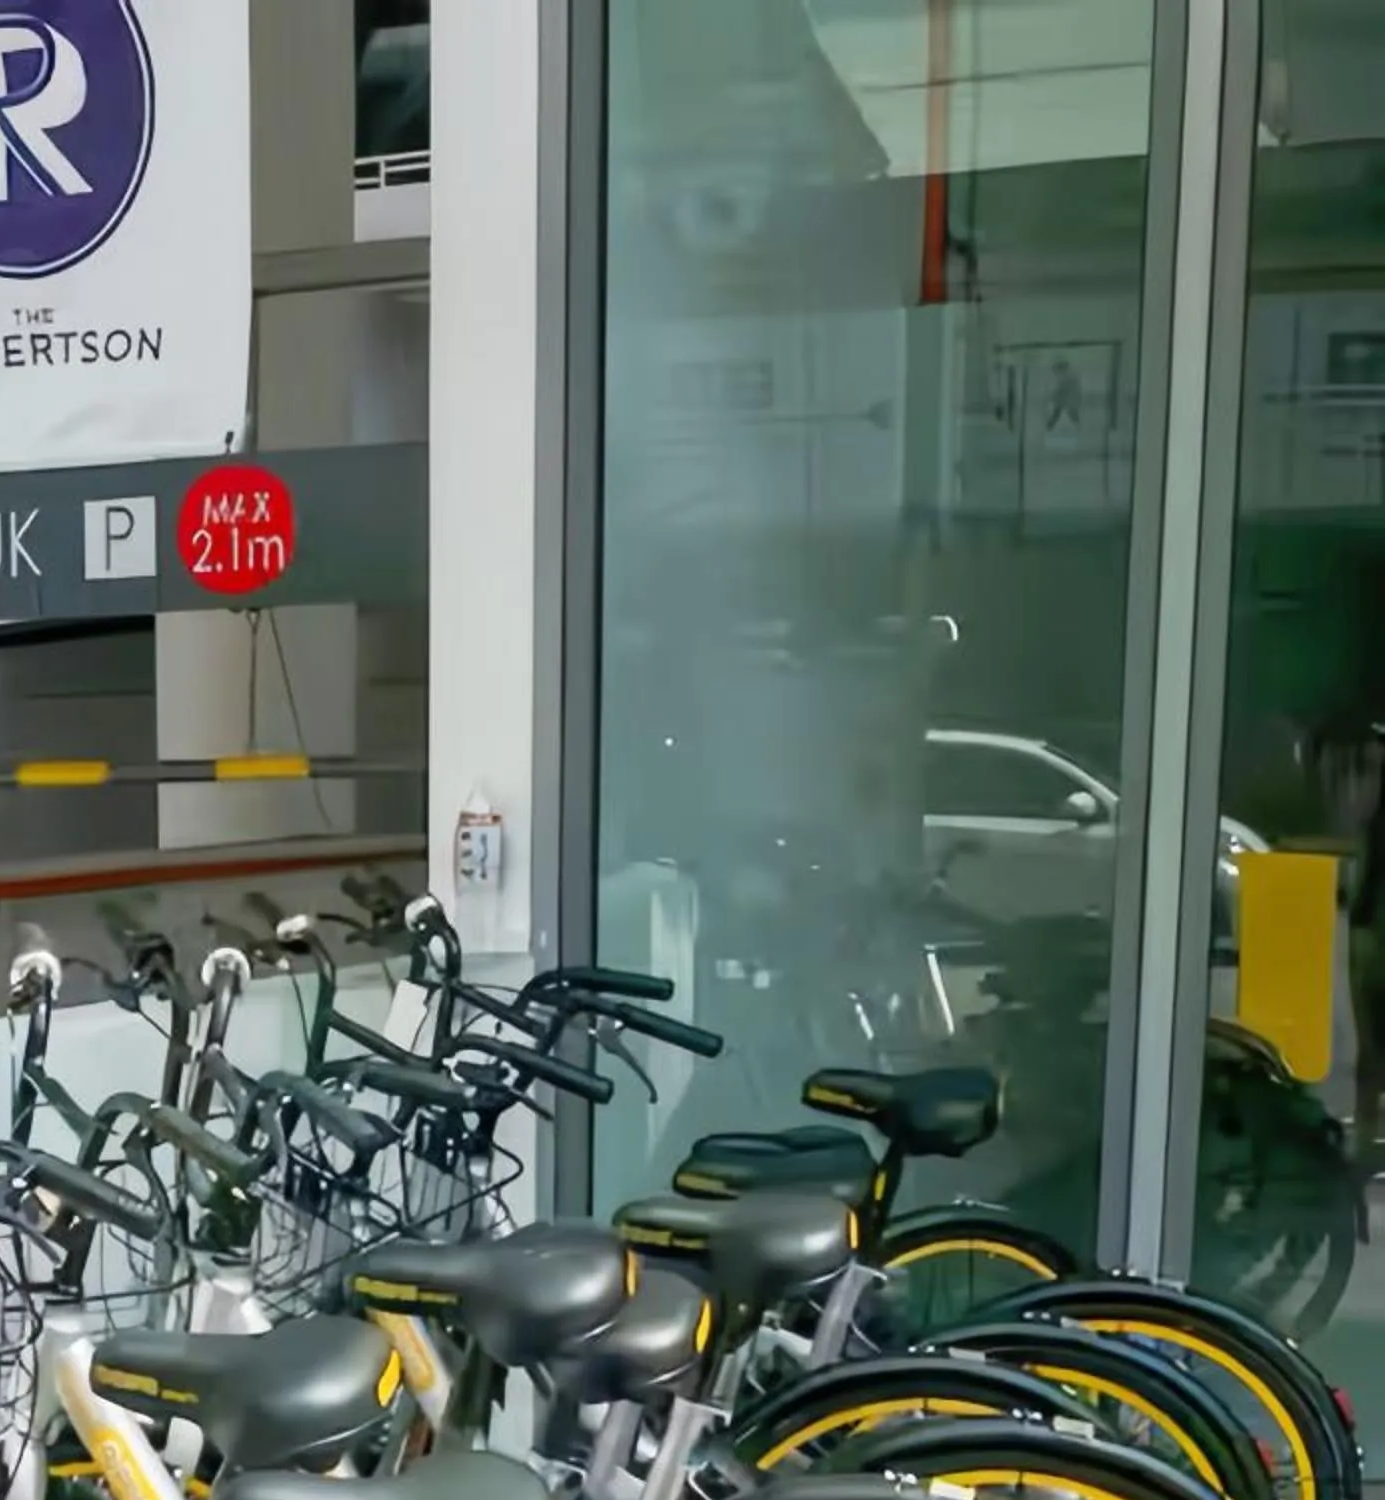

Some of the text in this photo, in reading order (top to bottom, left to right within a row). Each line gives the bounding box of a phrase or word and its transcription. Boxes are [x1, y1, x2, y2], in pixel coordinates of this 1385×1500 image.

[13, 308, 53, 324] THE
[203, 492, 270, 526] MAX
[106, 506, 134, 570] P
[191, 526, 285, 573] 2.1m
